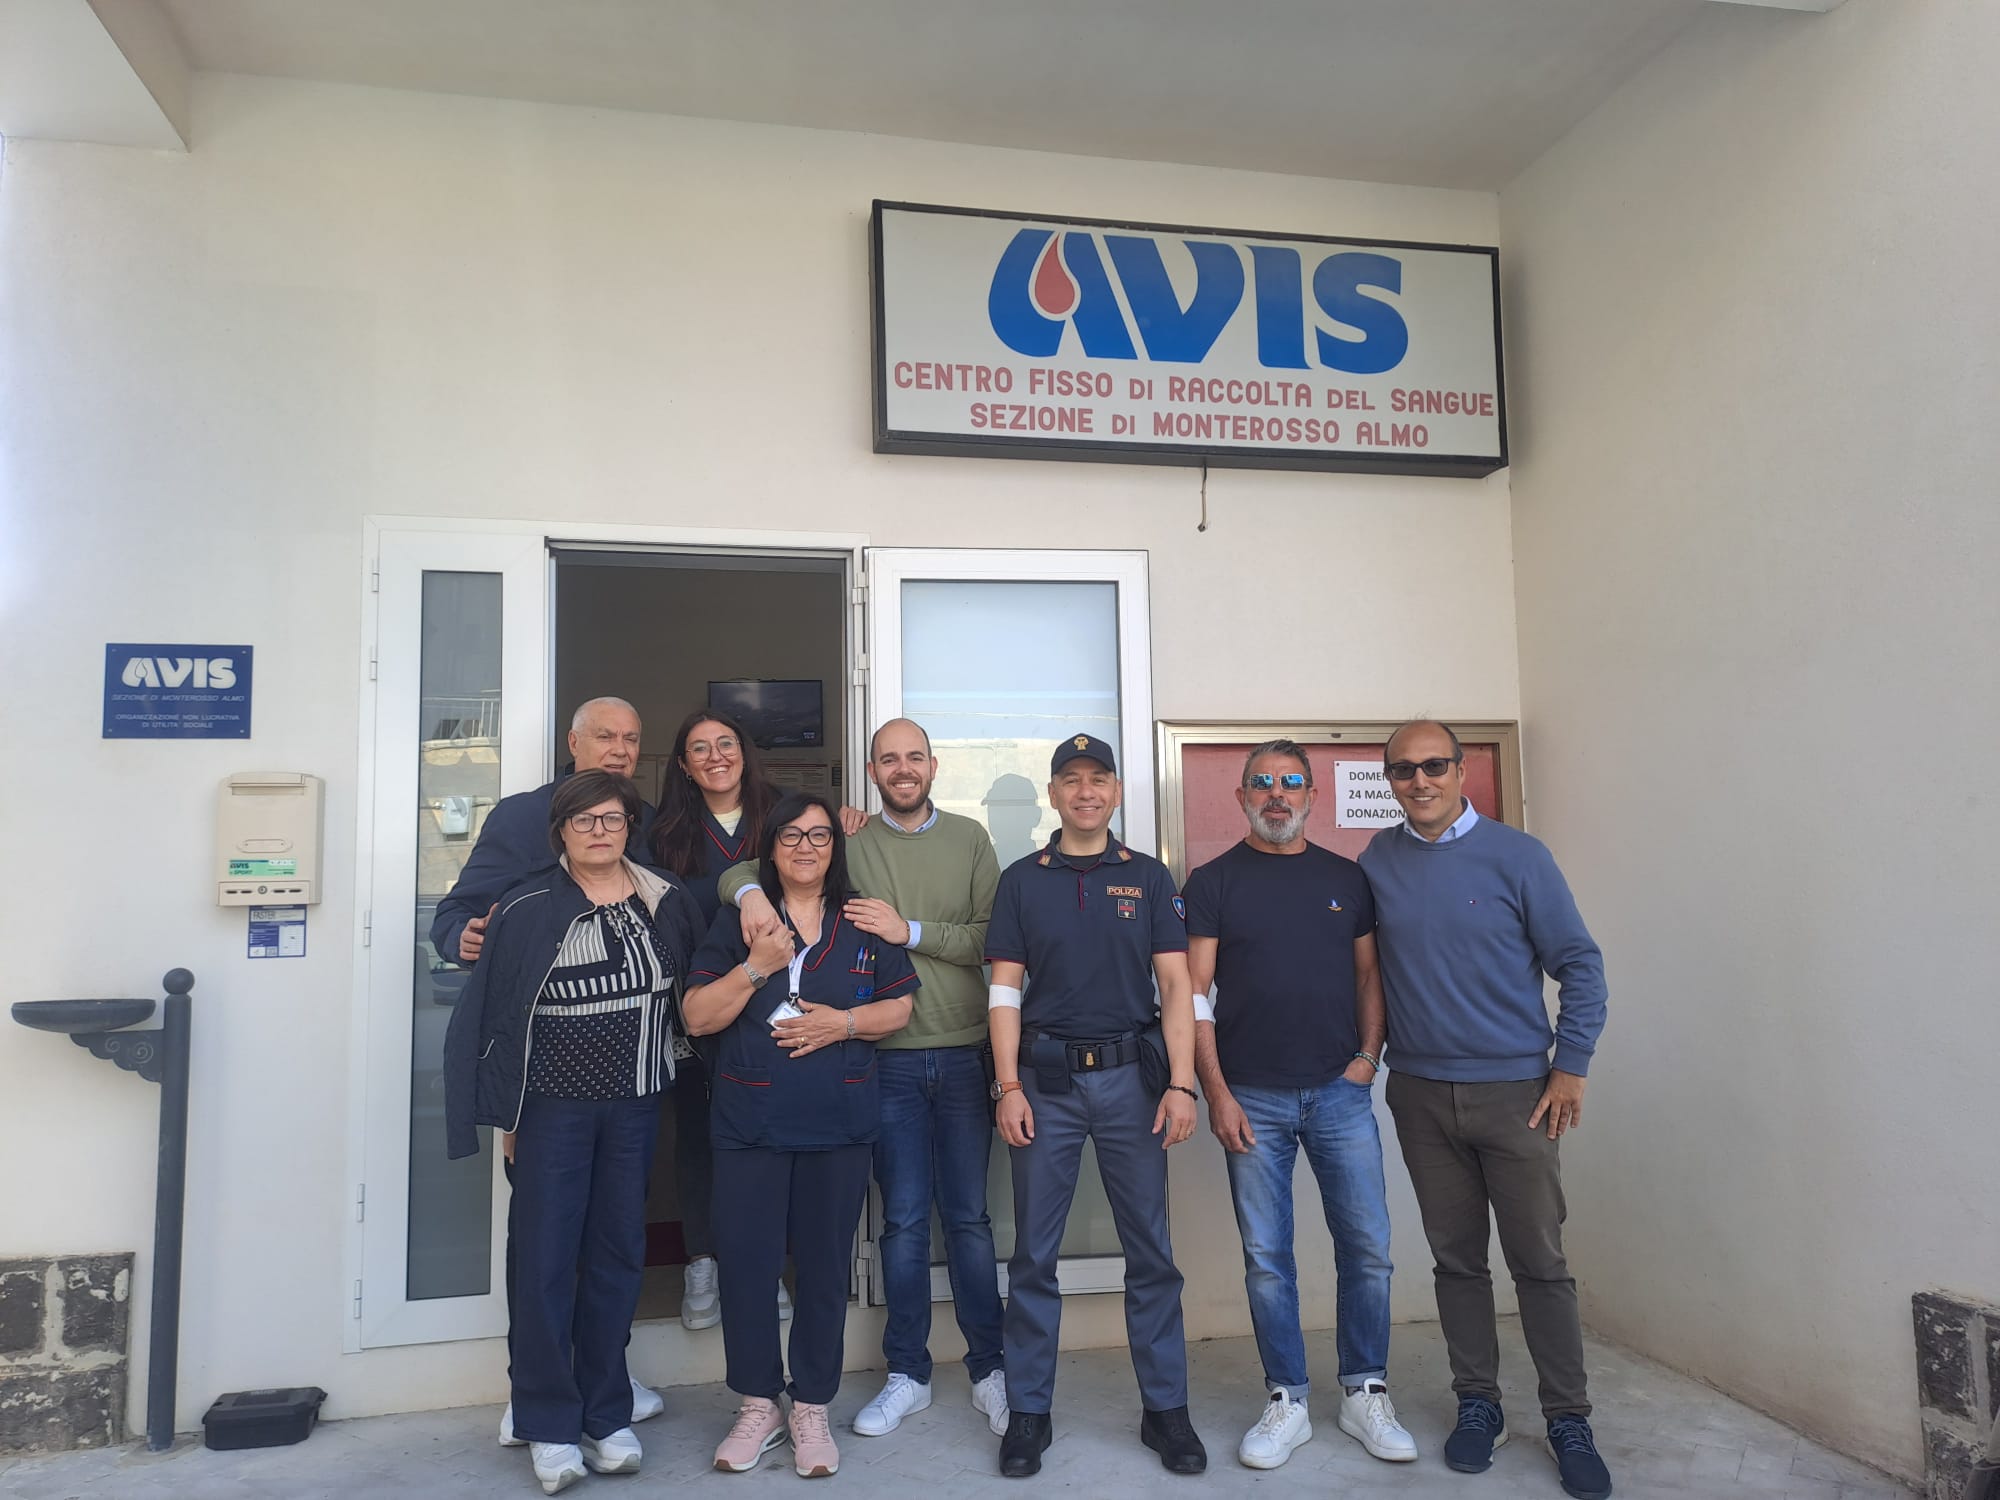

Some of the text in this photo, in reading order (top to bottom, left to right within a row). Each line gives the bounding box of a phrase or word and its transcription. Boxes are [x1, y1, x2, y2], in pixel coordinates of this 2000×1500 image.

[988, 229, 1409, 375] AVIS
[894, 361, 1494, 417] CENTRO FISSO DI RACCOLTA DEL SANGUE
[971, 402, 1429, 448] SEZIONE DI MONTEROSSO ALMO
[122, 657, 237, 689] AVIS
[1348, 789, 1361, 800] 24
[1108, 887, 1140, 897] POLIZIA
